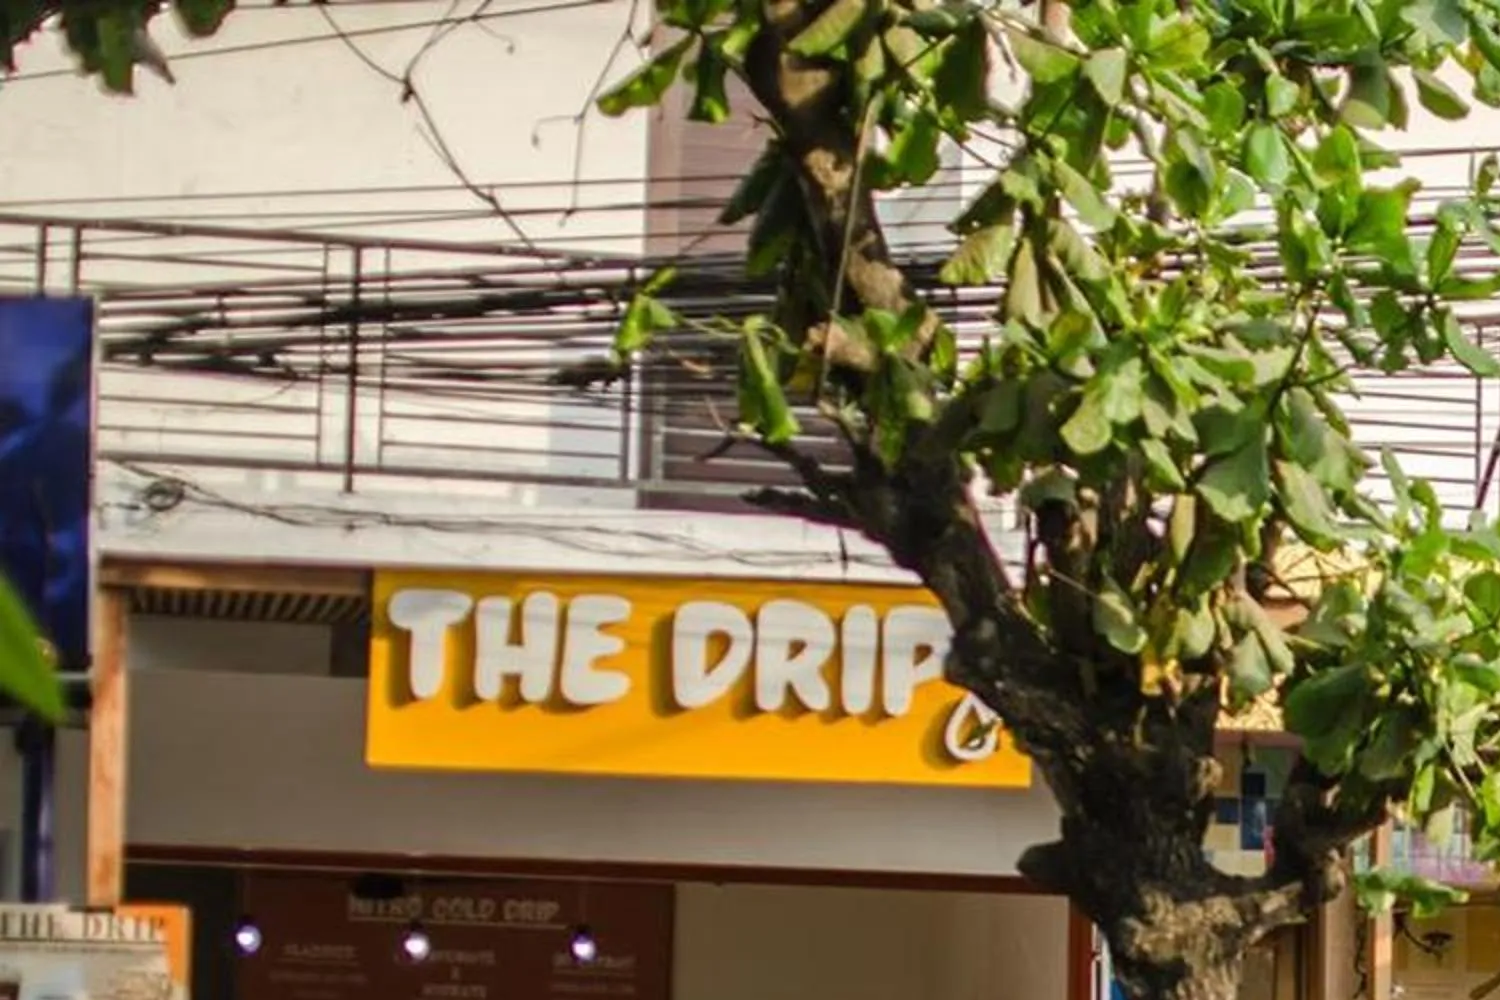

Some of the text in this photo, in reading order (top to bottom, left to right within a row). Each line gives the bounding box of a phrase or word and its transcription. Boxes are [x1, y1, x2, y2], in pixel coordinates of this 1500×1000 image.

[388, 589, 954, 716] THE DRIP
[82, 911, 167, 941] DRIP
